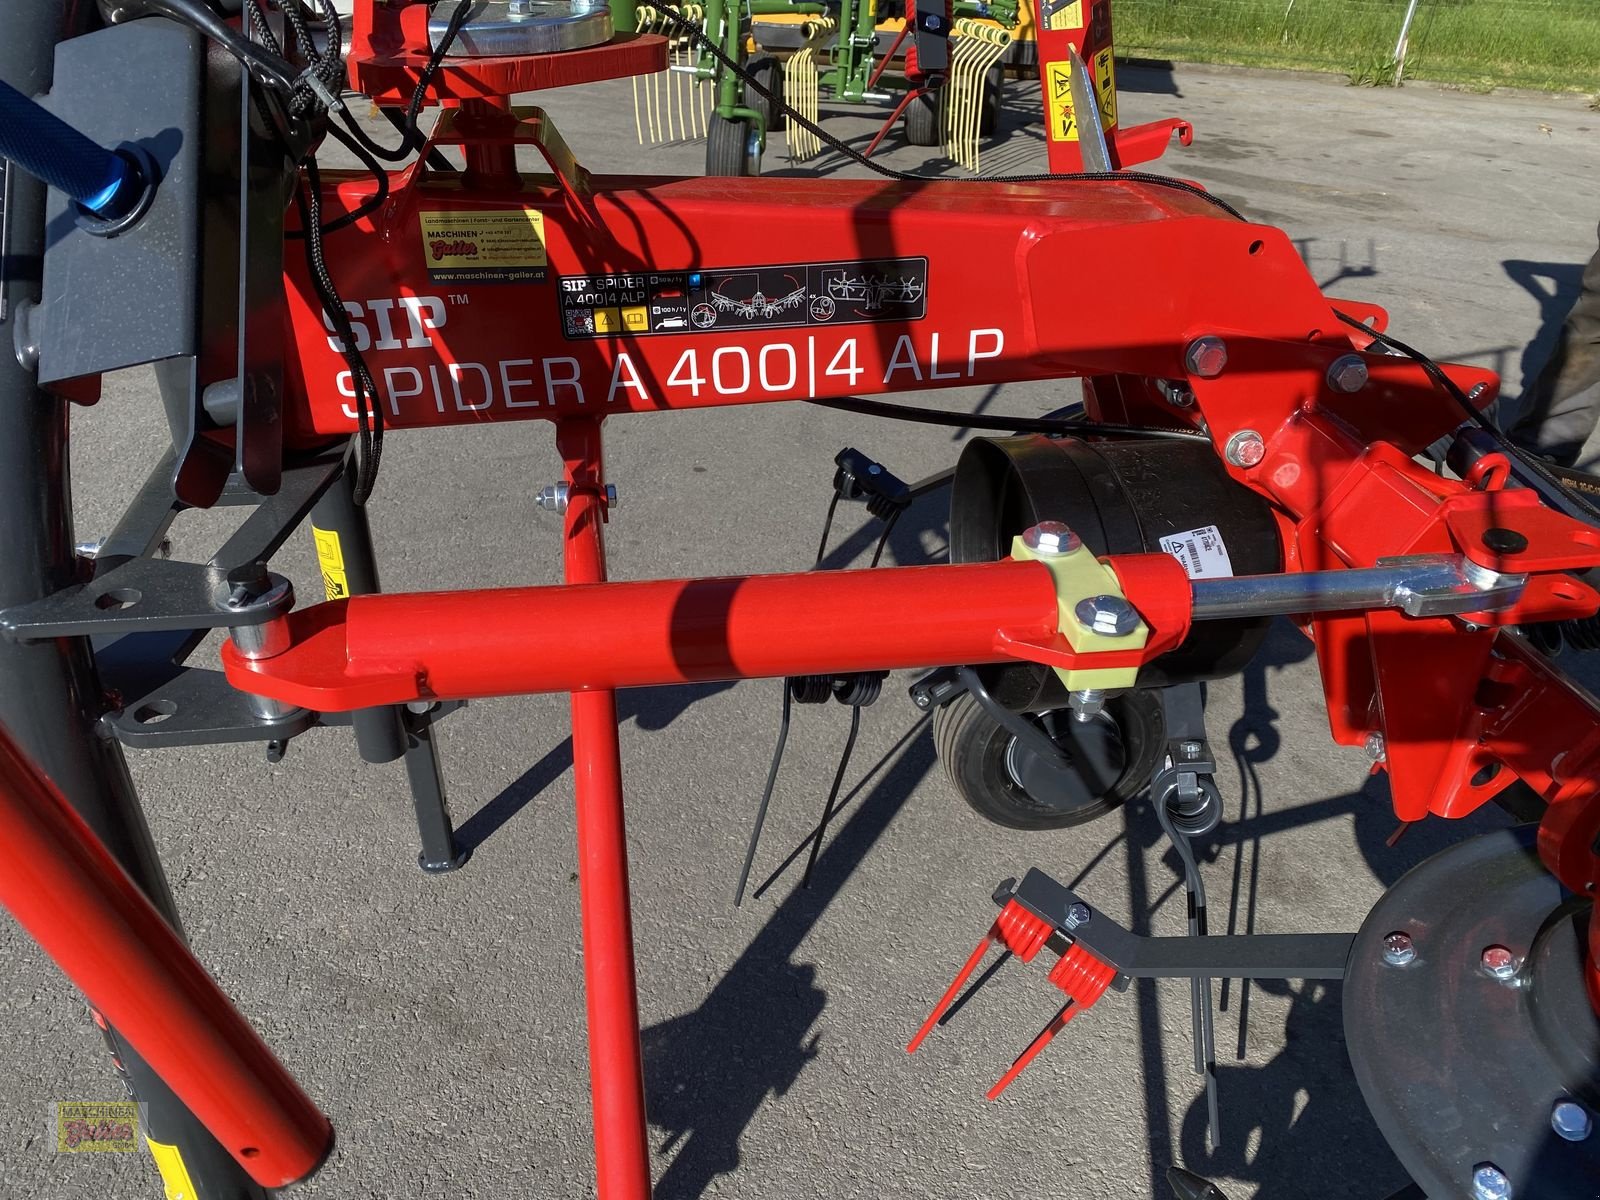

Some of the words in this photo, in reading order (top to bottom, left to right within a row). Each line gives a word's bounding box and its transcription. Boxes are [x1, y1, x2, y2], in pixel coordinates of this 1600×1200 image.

[427, 230, 478, 239] MASCHINEN
[429, 240, 478, 261] Gailer
[433, 271, 545, 281] www.maschinen-gailer.at
[562, 280, 587, 292] SIP
[596, 277, 645, 290] SPIDER
[565, 295, 574, 306] A
[620, 291, 645, 303] ALP
[321, 295, 447, 353] SIP
[607, 352, 648, 402] A
[883, 328, 1005, 384] ALP
